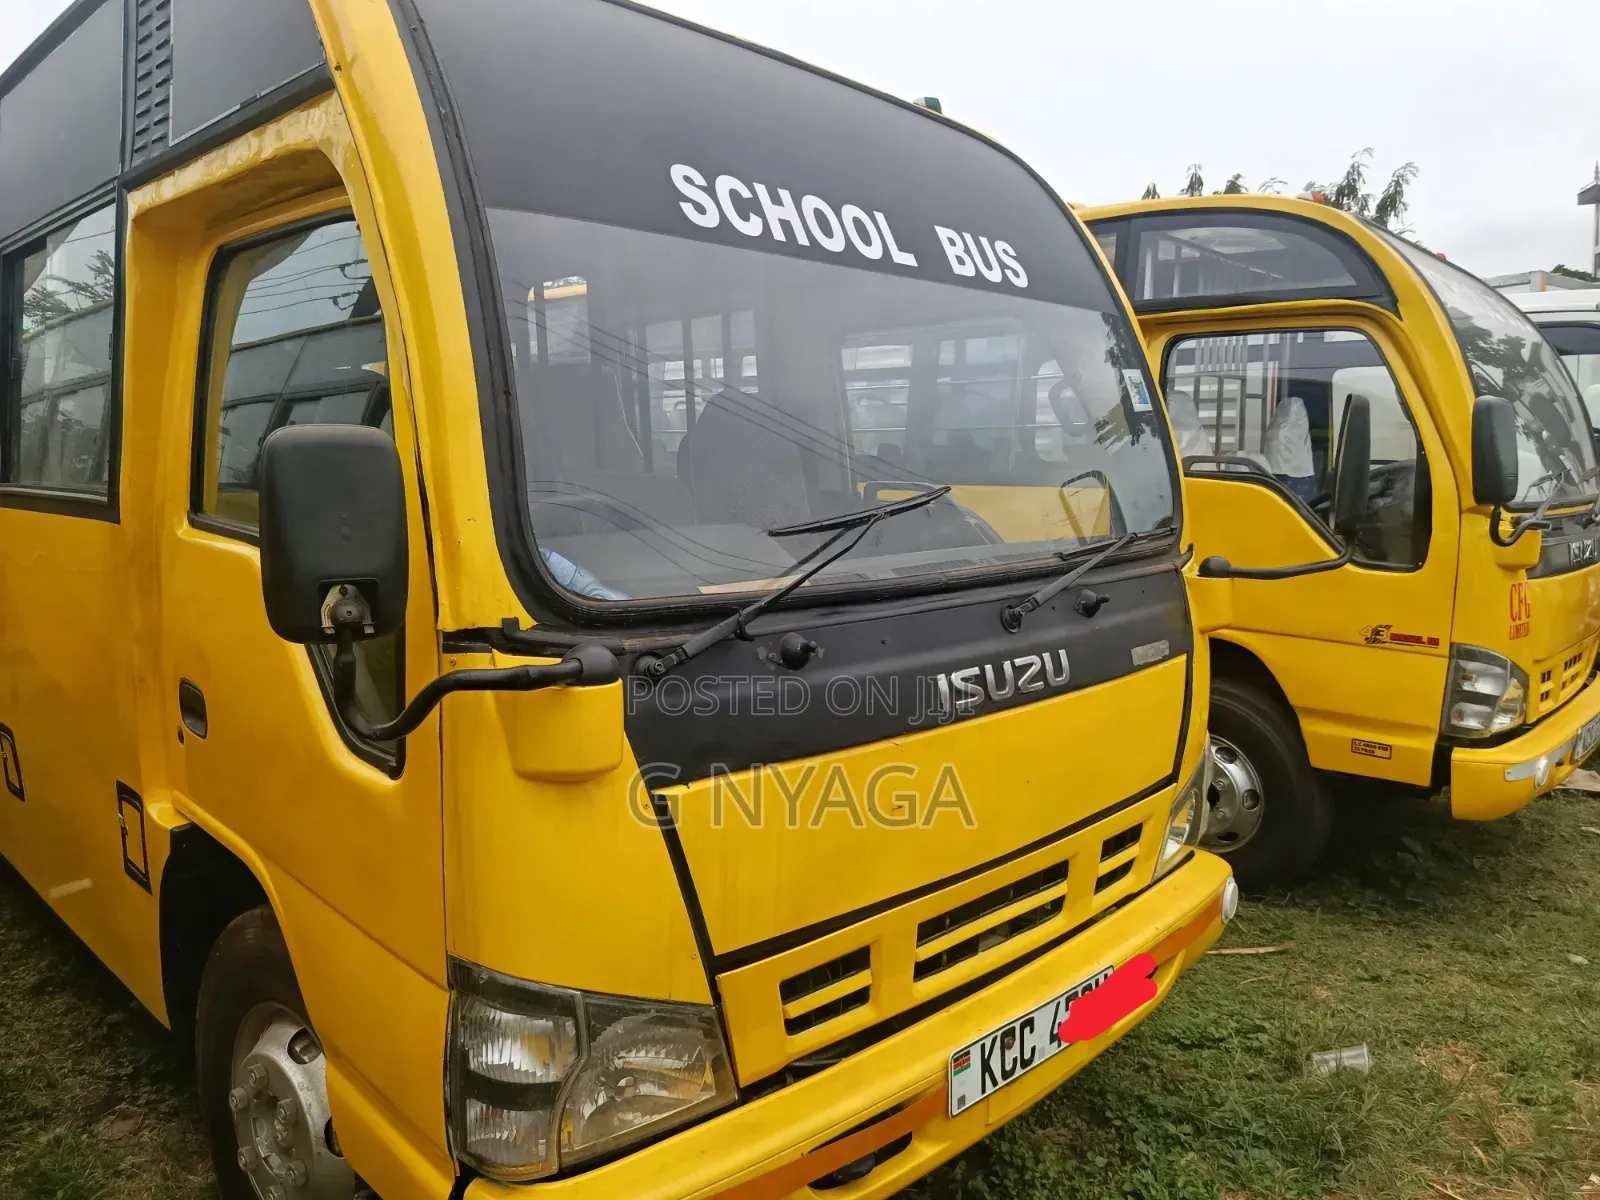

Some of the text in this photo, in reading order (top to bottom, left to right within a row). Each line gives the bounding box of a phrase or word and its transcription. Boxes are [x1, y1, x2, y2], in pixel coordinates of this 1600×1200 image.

[669, 163, 1029, 288] SCHOOL BUS
[936, 649, 1071, 713] ISUZU
[980, 1016, 1036, 1095] KCC
